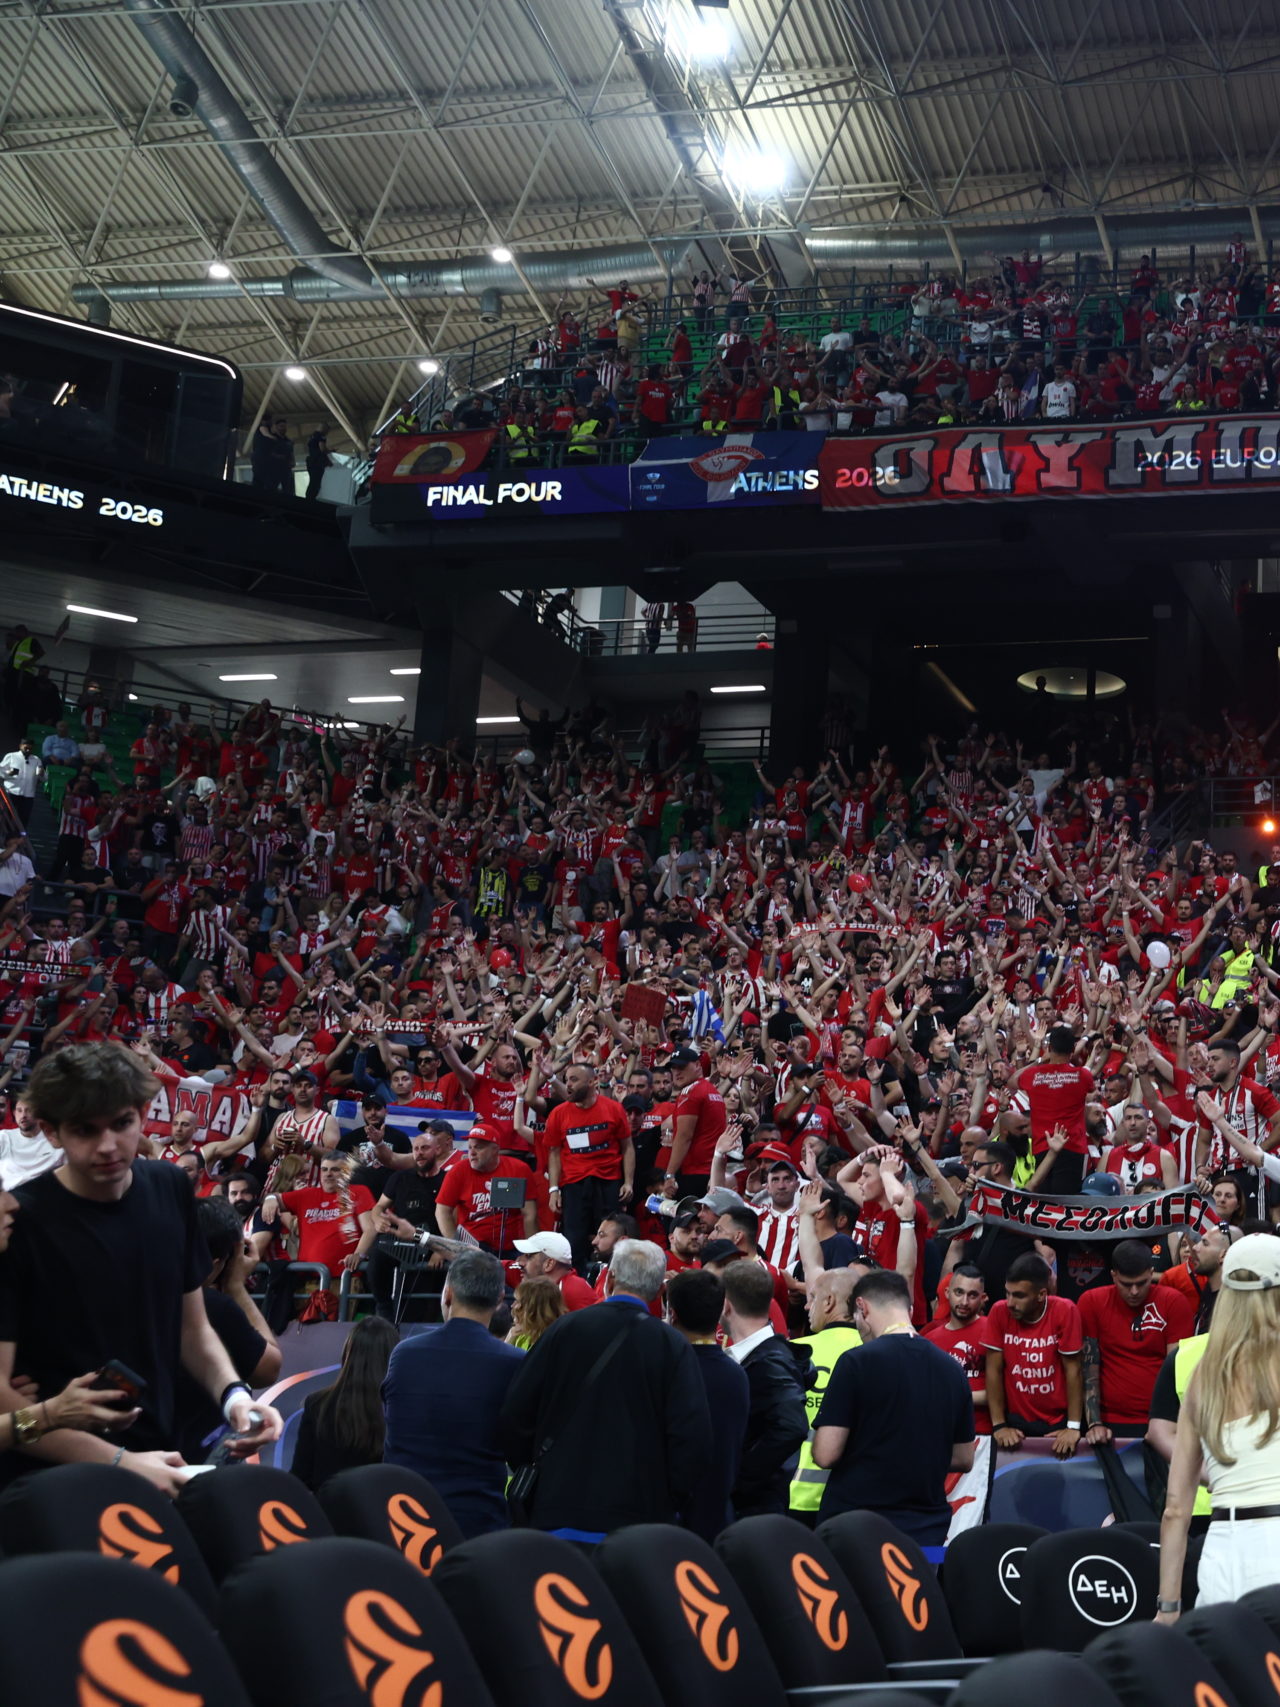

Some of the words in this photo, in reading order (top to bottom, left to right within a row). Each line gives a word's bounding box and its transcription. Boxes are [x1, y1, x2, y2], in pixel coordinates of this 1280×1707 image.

[1137, 450, 1202, 473] 2026
[426, 486, 491, 508] FINAL
[496, 480, 563, 504] FOUR
[729, 468, 820, 494] ATHENS
[835, 466, 901, 489] 2026
[0, 474, 85, 510] ATHENS
[98, 497, 164, 527] 2026
[567, 1123, 608, 1134] TOMMY
[1076, 1573, 1129, 1604] ΔΕΗ
